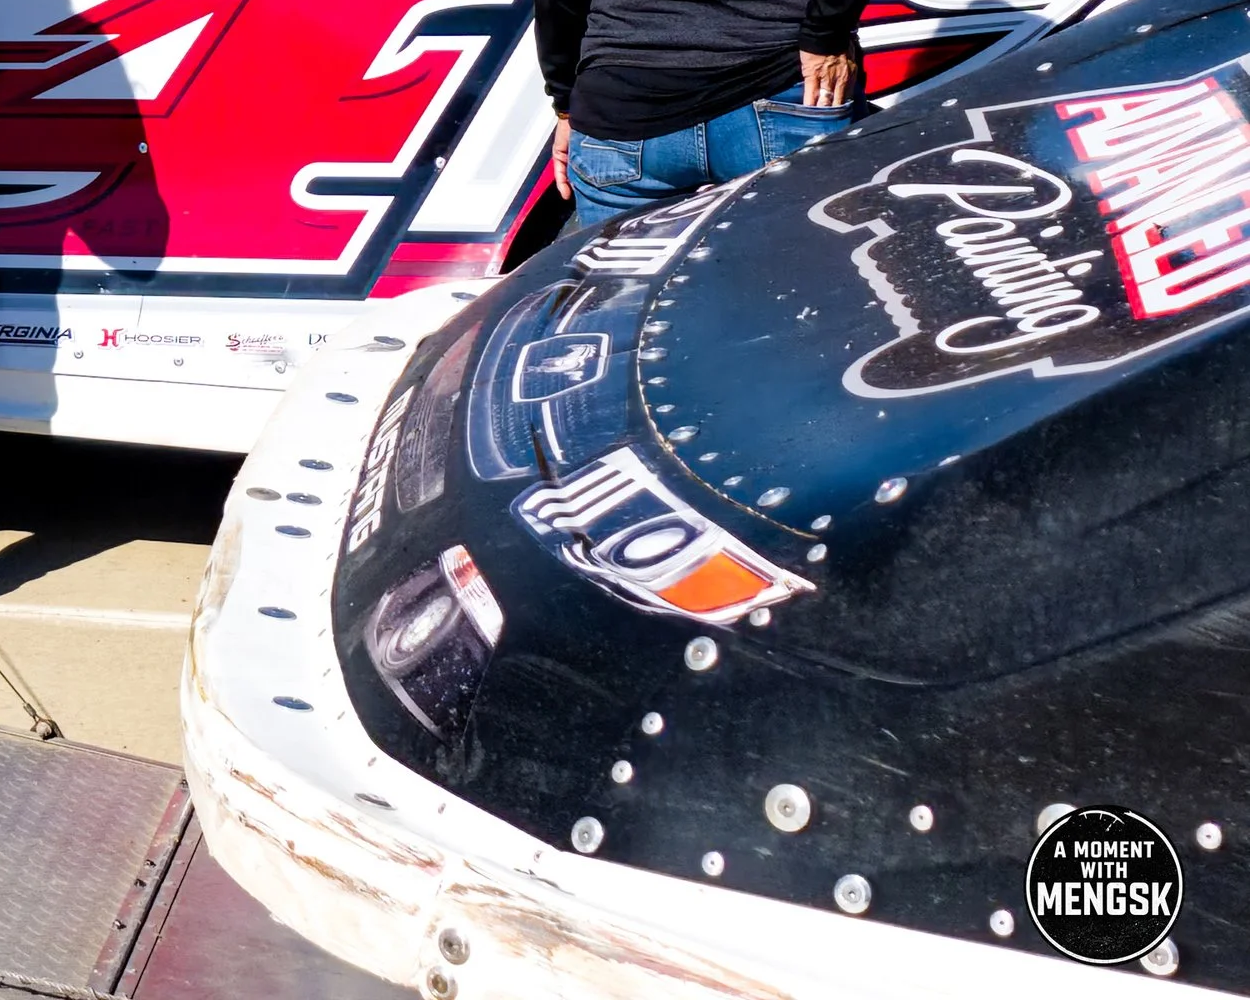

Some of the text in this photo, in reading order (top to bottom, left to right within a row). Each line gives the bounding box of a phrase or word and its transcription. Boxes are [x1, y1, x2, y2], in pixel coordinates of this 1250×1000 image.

[888, 149, 1104, 353] Painting
[124, 333, 202, 345] HOOSIER
[348, 385, 415, 552] MUSTANG
